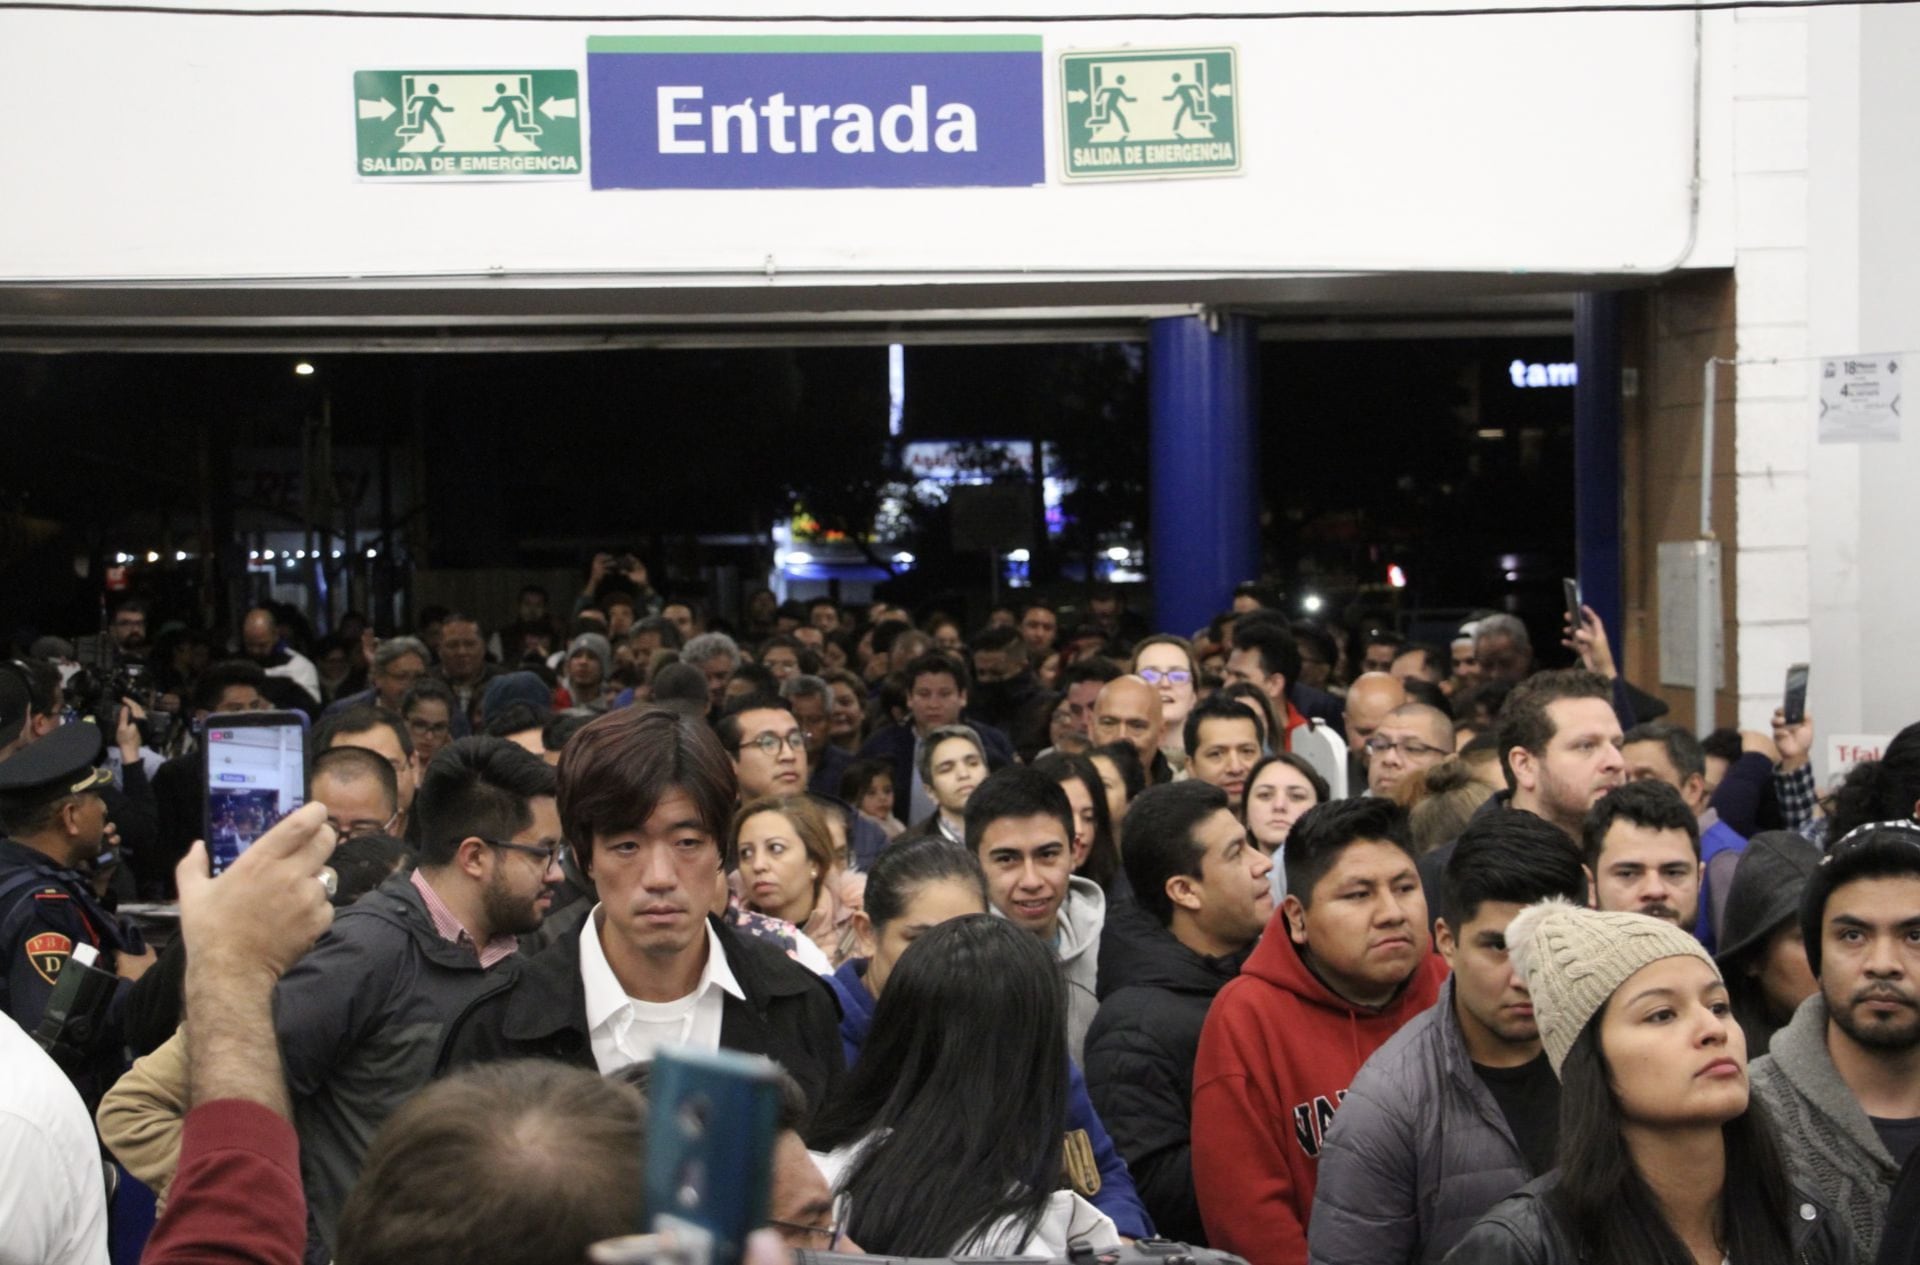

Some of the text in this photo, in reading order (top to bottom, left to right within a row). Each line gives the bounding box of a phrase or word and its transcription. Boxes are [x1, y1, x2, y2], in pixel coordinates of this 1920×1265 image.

[657, 85, 977, 153] Entrada
[362, 156, 578, 172] SALIDA DE EMERGENCIA
[1073, 142, 1233, 166] SALIDA DE EMERGENCIA
[44, 956, 61, 972] D
